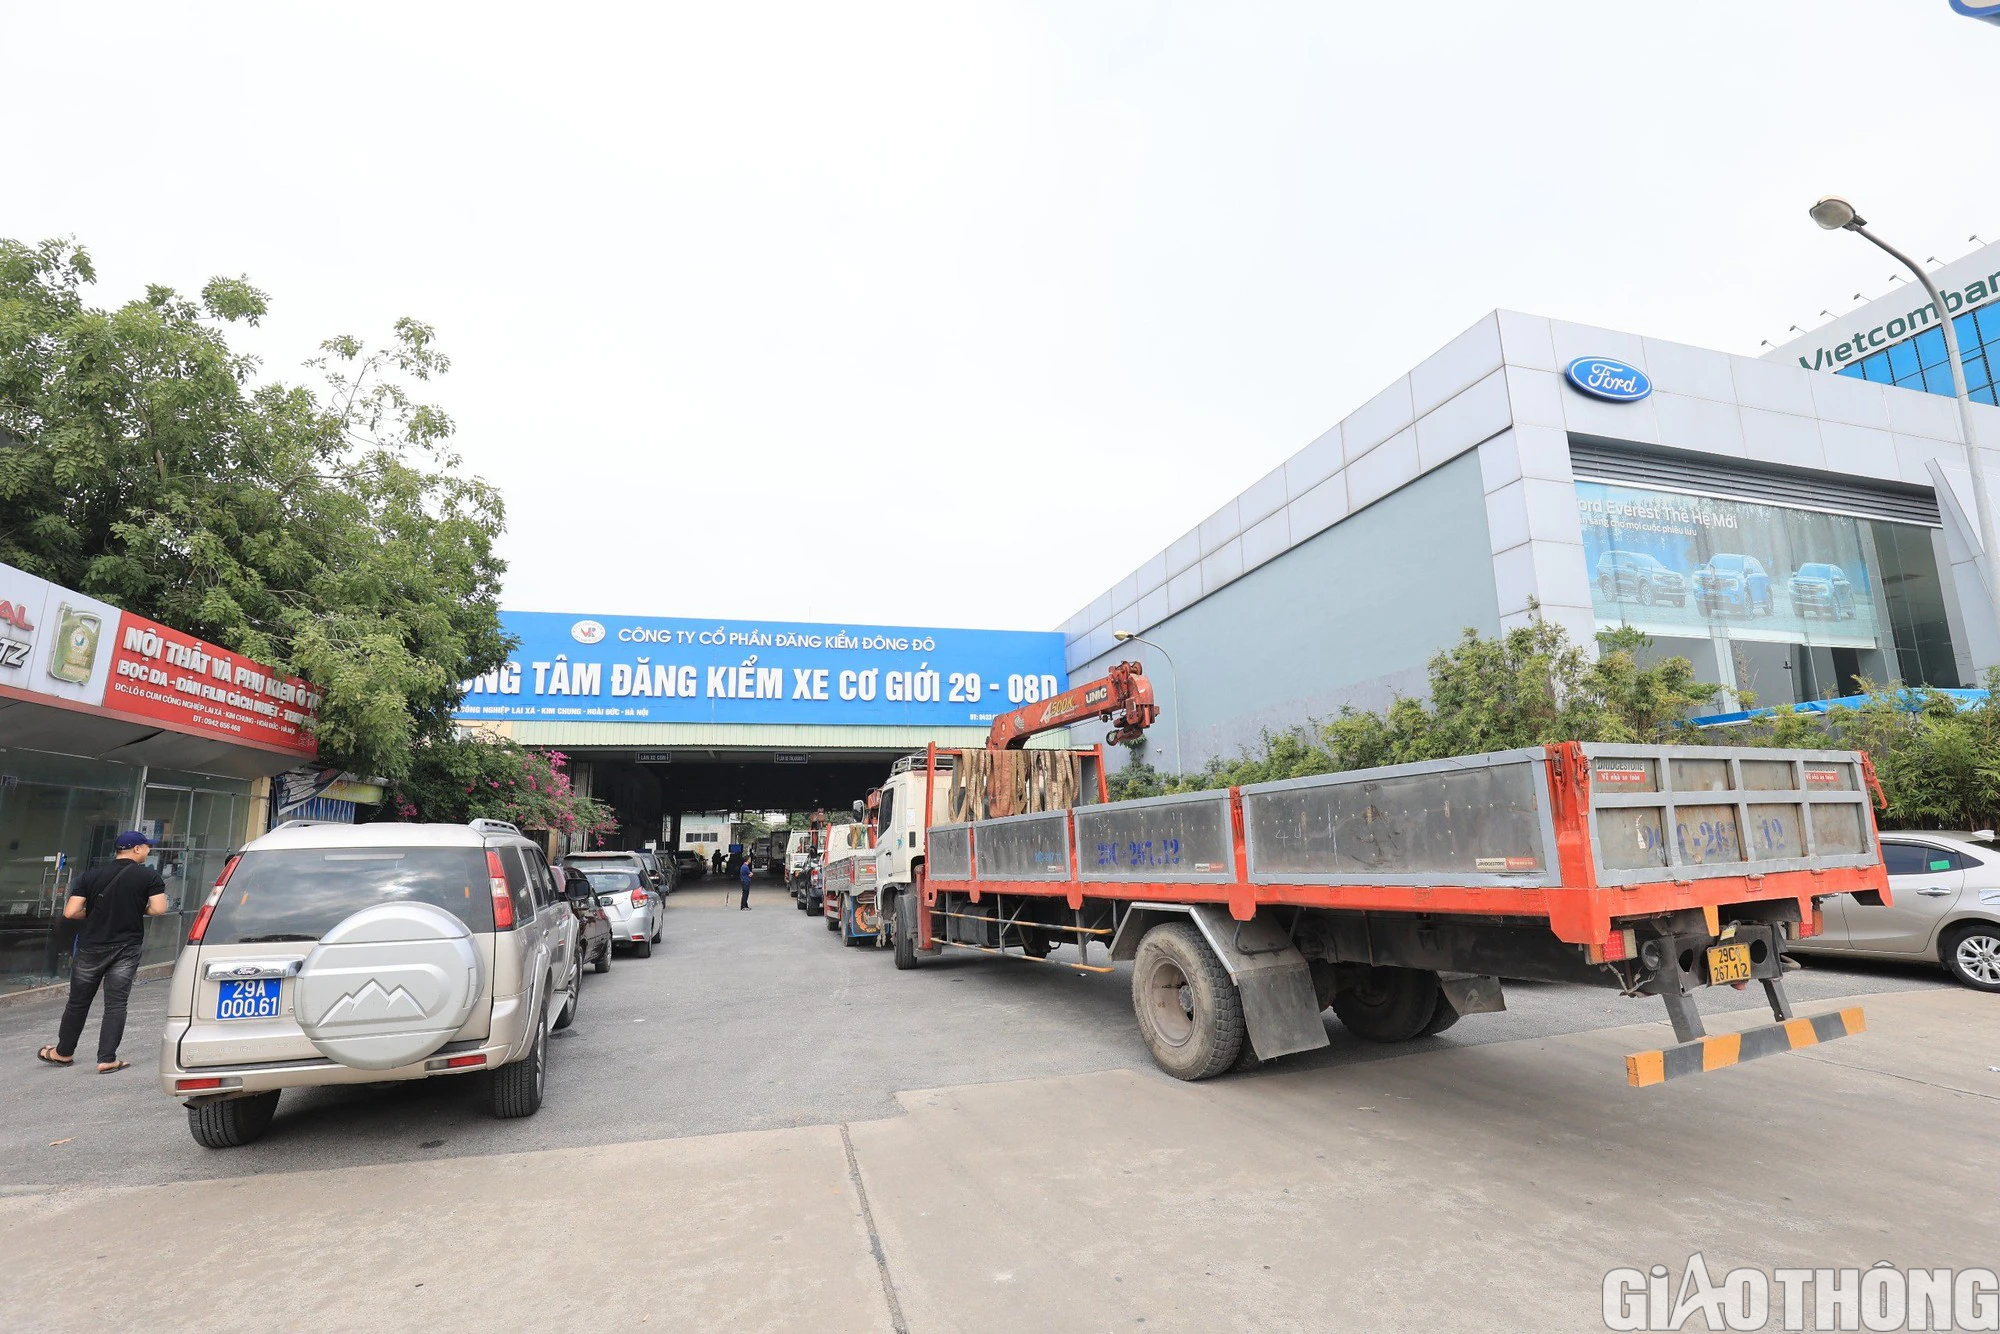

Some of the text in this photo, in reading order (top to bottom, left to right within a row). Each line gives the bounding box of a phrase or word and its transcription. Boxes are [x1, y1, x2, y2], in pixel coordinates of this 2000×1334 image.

[1588, 363, 1637, 392] Ford
[1607, 500, 1660, 519] Everest
[1662, 505, 1689, 523] Thế
[1692, 508, 1710, 528] Hệ
[1713, 512, 1738, 529] Mới
[1610, 517, 1624, 528] cho
[618, 627, 672, 644] CÔNG
[677, 631, 696, 644] TY
[699, 626, 726, 645] CỔ
[729, 629, 772, 646] PHẦN
[775, 632, 822, 648] ĐĂNG
[825, 630, 858, 649] KIỂM
[862, 635, 908, 651] ĐÔNG
[912, 636, 935, 652] ĐÔ
[123, 626, 164, 662] NỘI
[166, 642, 211, 674] THẤT
[211, 656, 231, 683] VÀ
[233, 666, 265, 698] PHỤ
[296, 684, 307, 707] Ô
[532, 654, 601, 696] TÂM
[611, 657, 697, 697] ĐĂNG
[706, 654, 783, 699] KIỂM
[792, 668, 829, 700] XE
[839, 668, 879, 701] CƠ
[885, 662, 940, 702] GIỚI
[948, 673, 981, 702] 29
[990, 683, 999, 691] -
[1008, 674, 1058, 703] 08D
[117, 659, 149, 682] BỌC
[149, 669, 168, 687] DA
[175, 675, 201, 696] DÁN
[201, 684, 226, 703] FILM
[226, 690, 254, 711] CÁCH
[253, 700, 279, 719] NHIỆT
[139, 689, 145, 697] 6
[145, 690, 162, 702] CỤM
[162, 694, 181, 706] CÔNG
[1086, 688, 1107, 704] UNIC
[483, 705, 510, 715] NGHIỆP
[511, 706, 523, 714] LAI
[525, 706, 536, 714] XÁ
[557, 707, 582, 715] CHUNG
[587, 706, 604, 716] HOÀI
[605, 706, 620, 716] ĐỨC
[624, 707, 635, 716] HÀ
[636, 707, 649, 718] NỘI
[1718, 947, 1736, 963] 29C
[1714, 963, 1749, 982] 267.12
[232, 980, 266, 998] 29A
[221, 997, 277, 1017] 000.61
